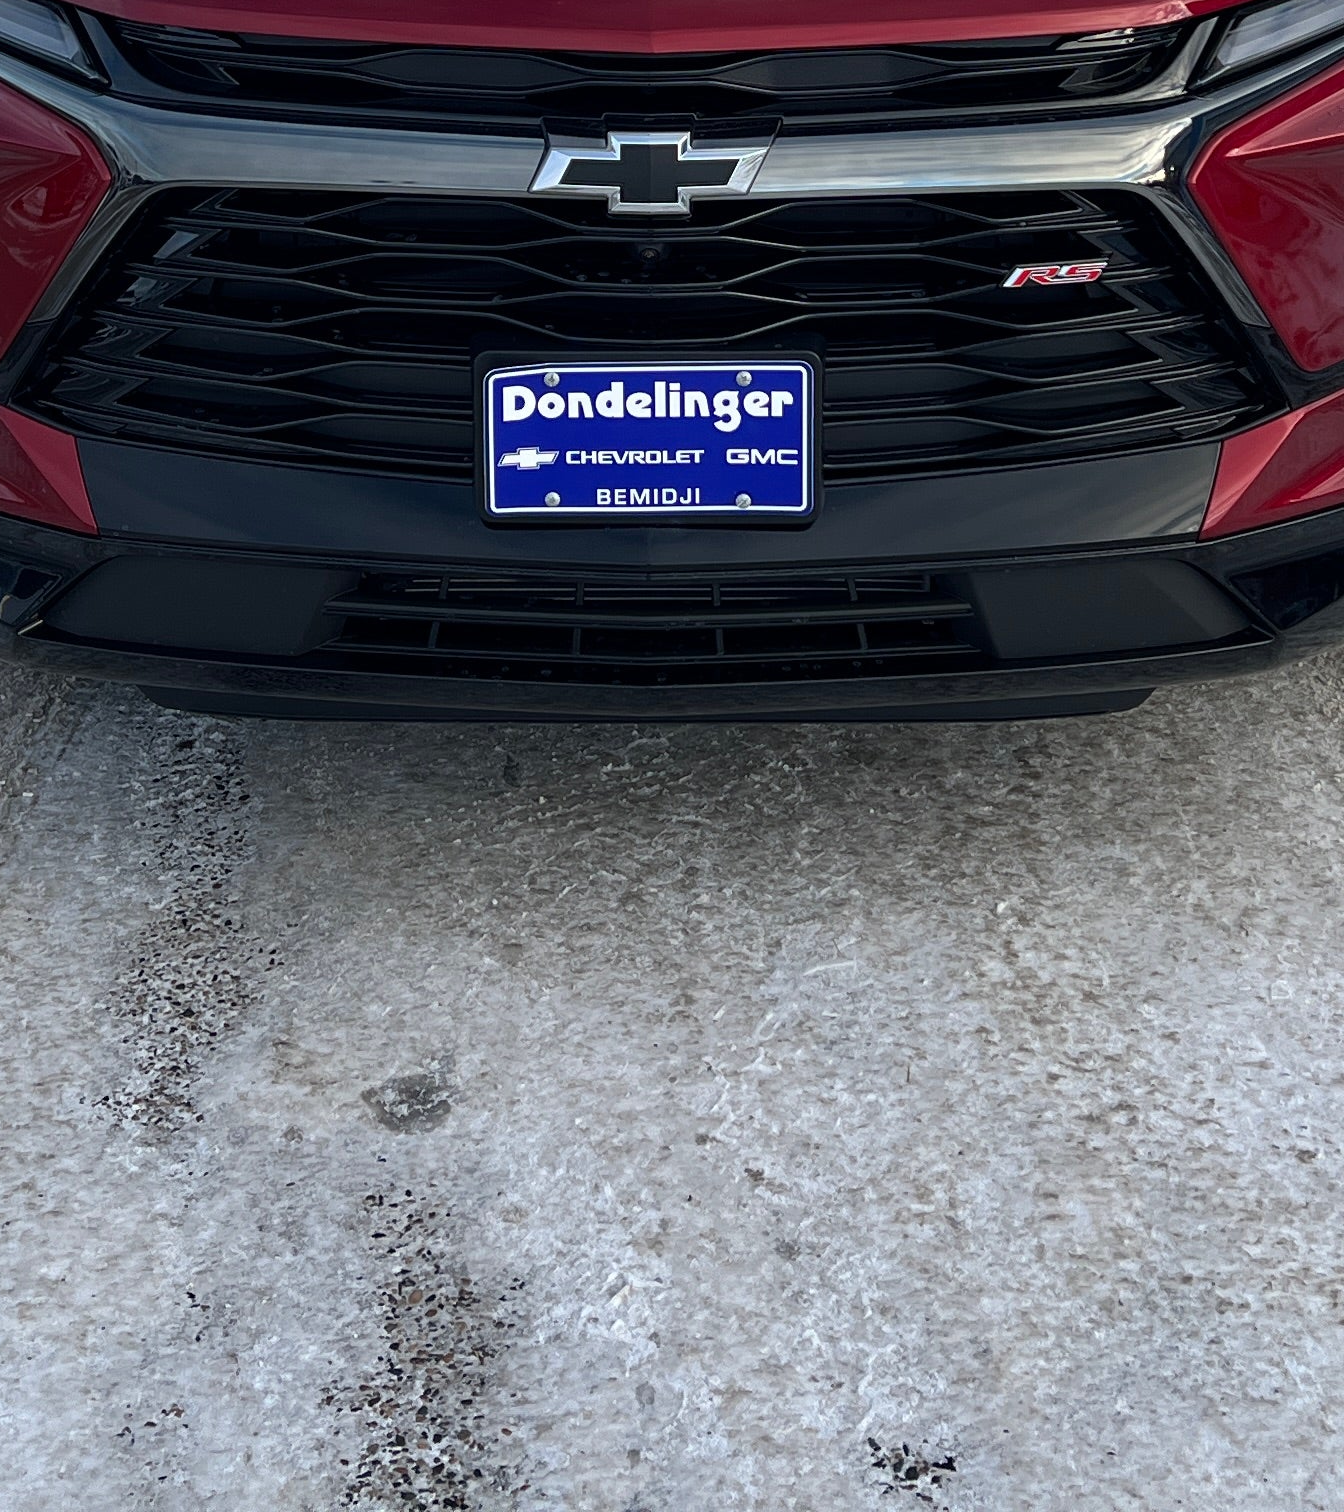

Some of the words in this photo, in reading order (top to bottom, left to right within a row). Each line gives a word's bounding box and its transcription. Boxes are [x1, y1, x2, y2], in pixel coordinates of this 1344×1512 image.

[1002, 262, 1108, 288] RS
[502, 381, 794, 432] Dondelinger
[565, 449, 705, 464] CHEVROLET
[725, 448, 799, 465] GMC
[596, 488, 701, 505] BEMIDJI
